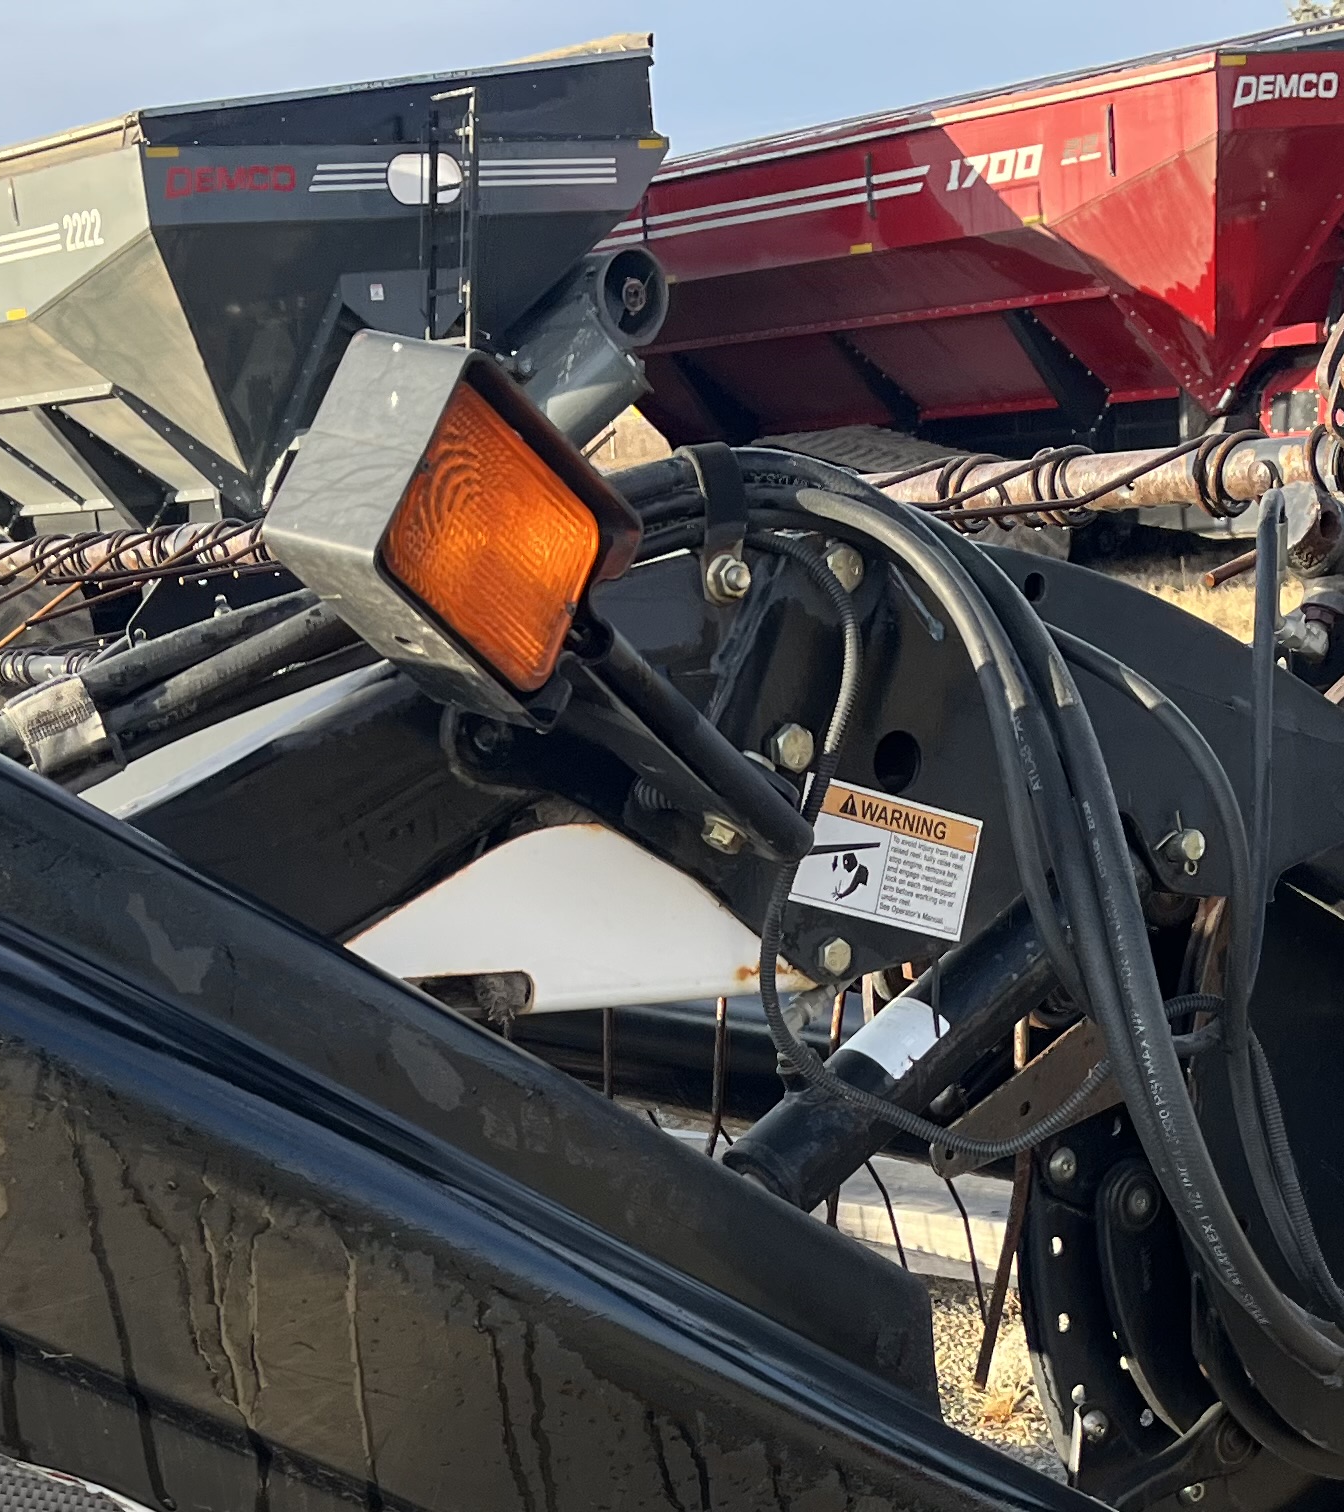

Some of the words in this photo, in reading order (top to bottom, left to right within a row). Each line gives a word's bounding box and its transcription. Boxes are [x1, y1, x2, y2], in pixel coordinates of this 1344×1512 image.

[1233, 72, 1339, 108] DEMCO
[165, 163, 297, 199] DEMCO
[946, 144, 1044, 191] 1700
[62, 208, 105, 252] 2222
[861, 800, 945, 839] WARNING
